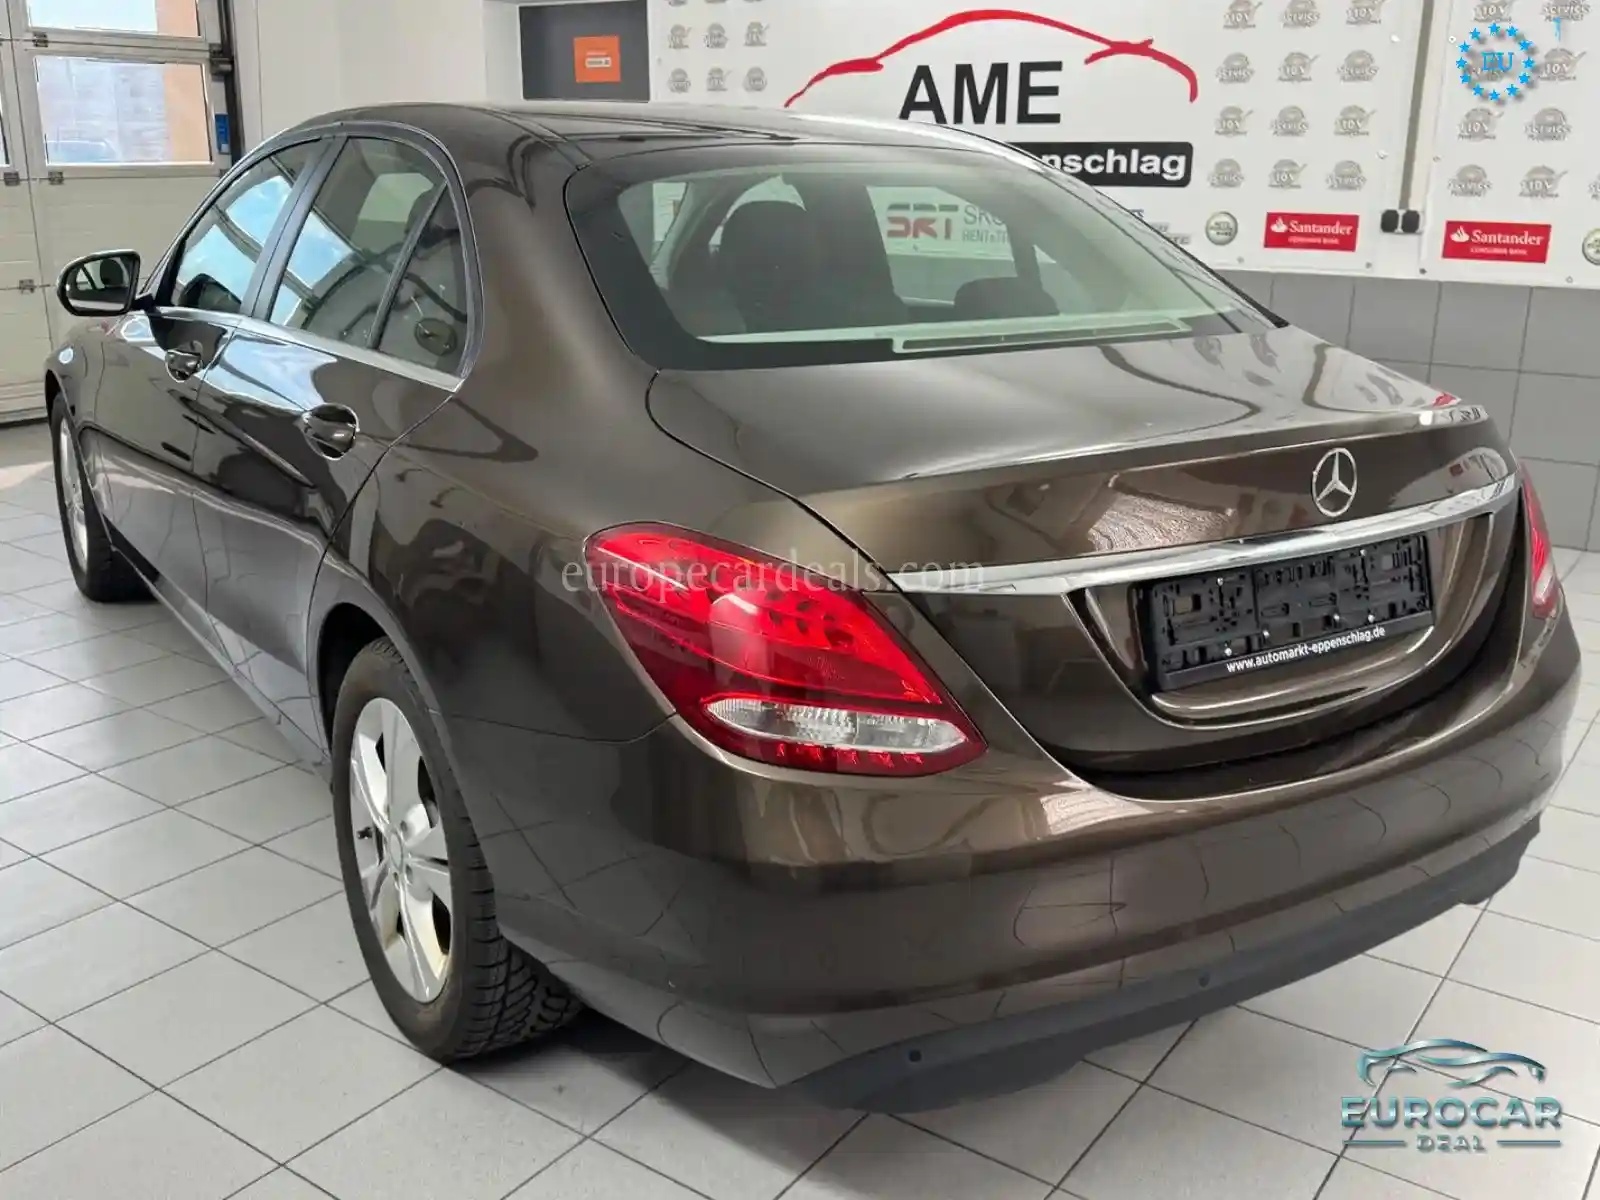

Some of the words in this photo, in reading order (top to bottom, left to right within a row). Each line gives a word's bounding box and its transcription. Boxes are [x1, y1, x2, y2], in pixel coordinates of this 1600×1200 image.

[899, 61, 1063, 124] AME
[1041, 149, 1187, 181] nschlag
[1289, 220, 1354, 235] Santander
[1471, 229, 1545, 246] Santander
[1226, 625, 1386, 673] www.automarkt-eppenschlag.de
